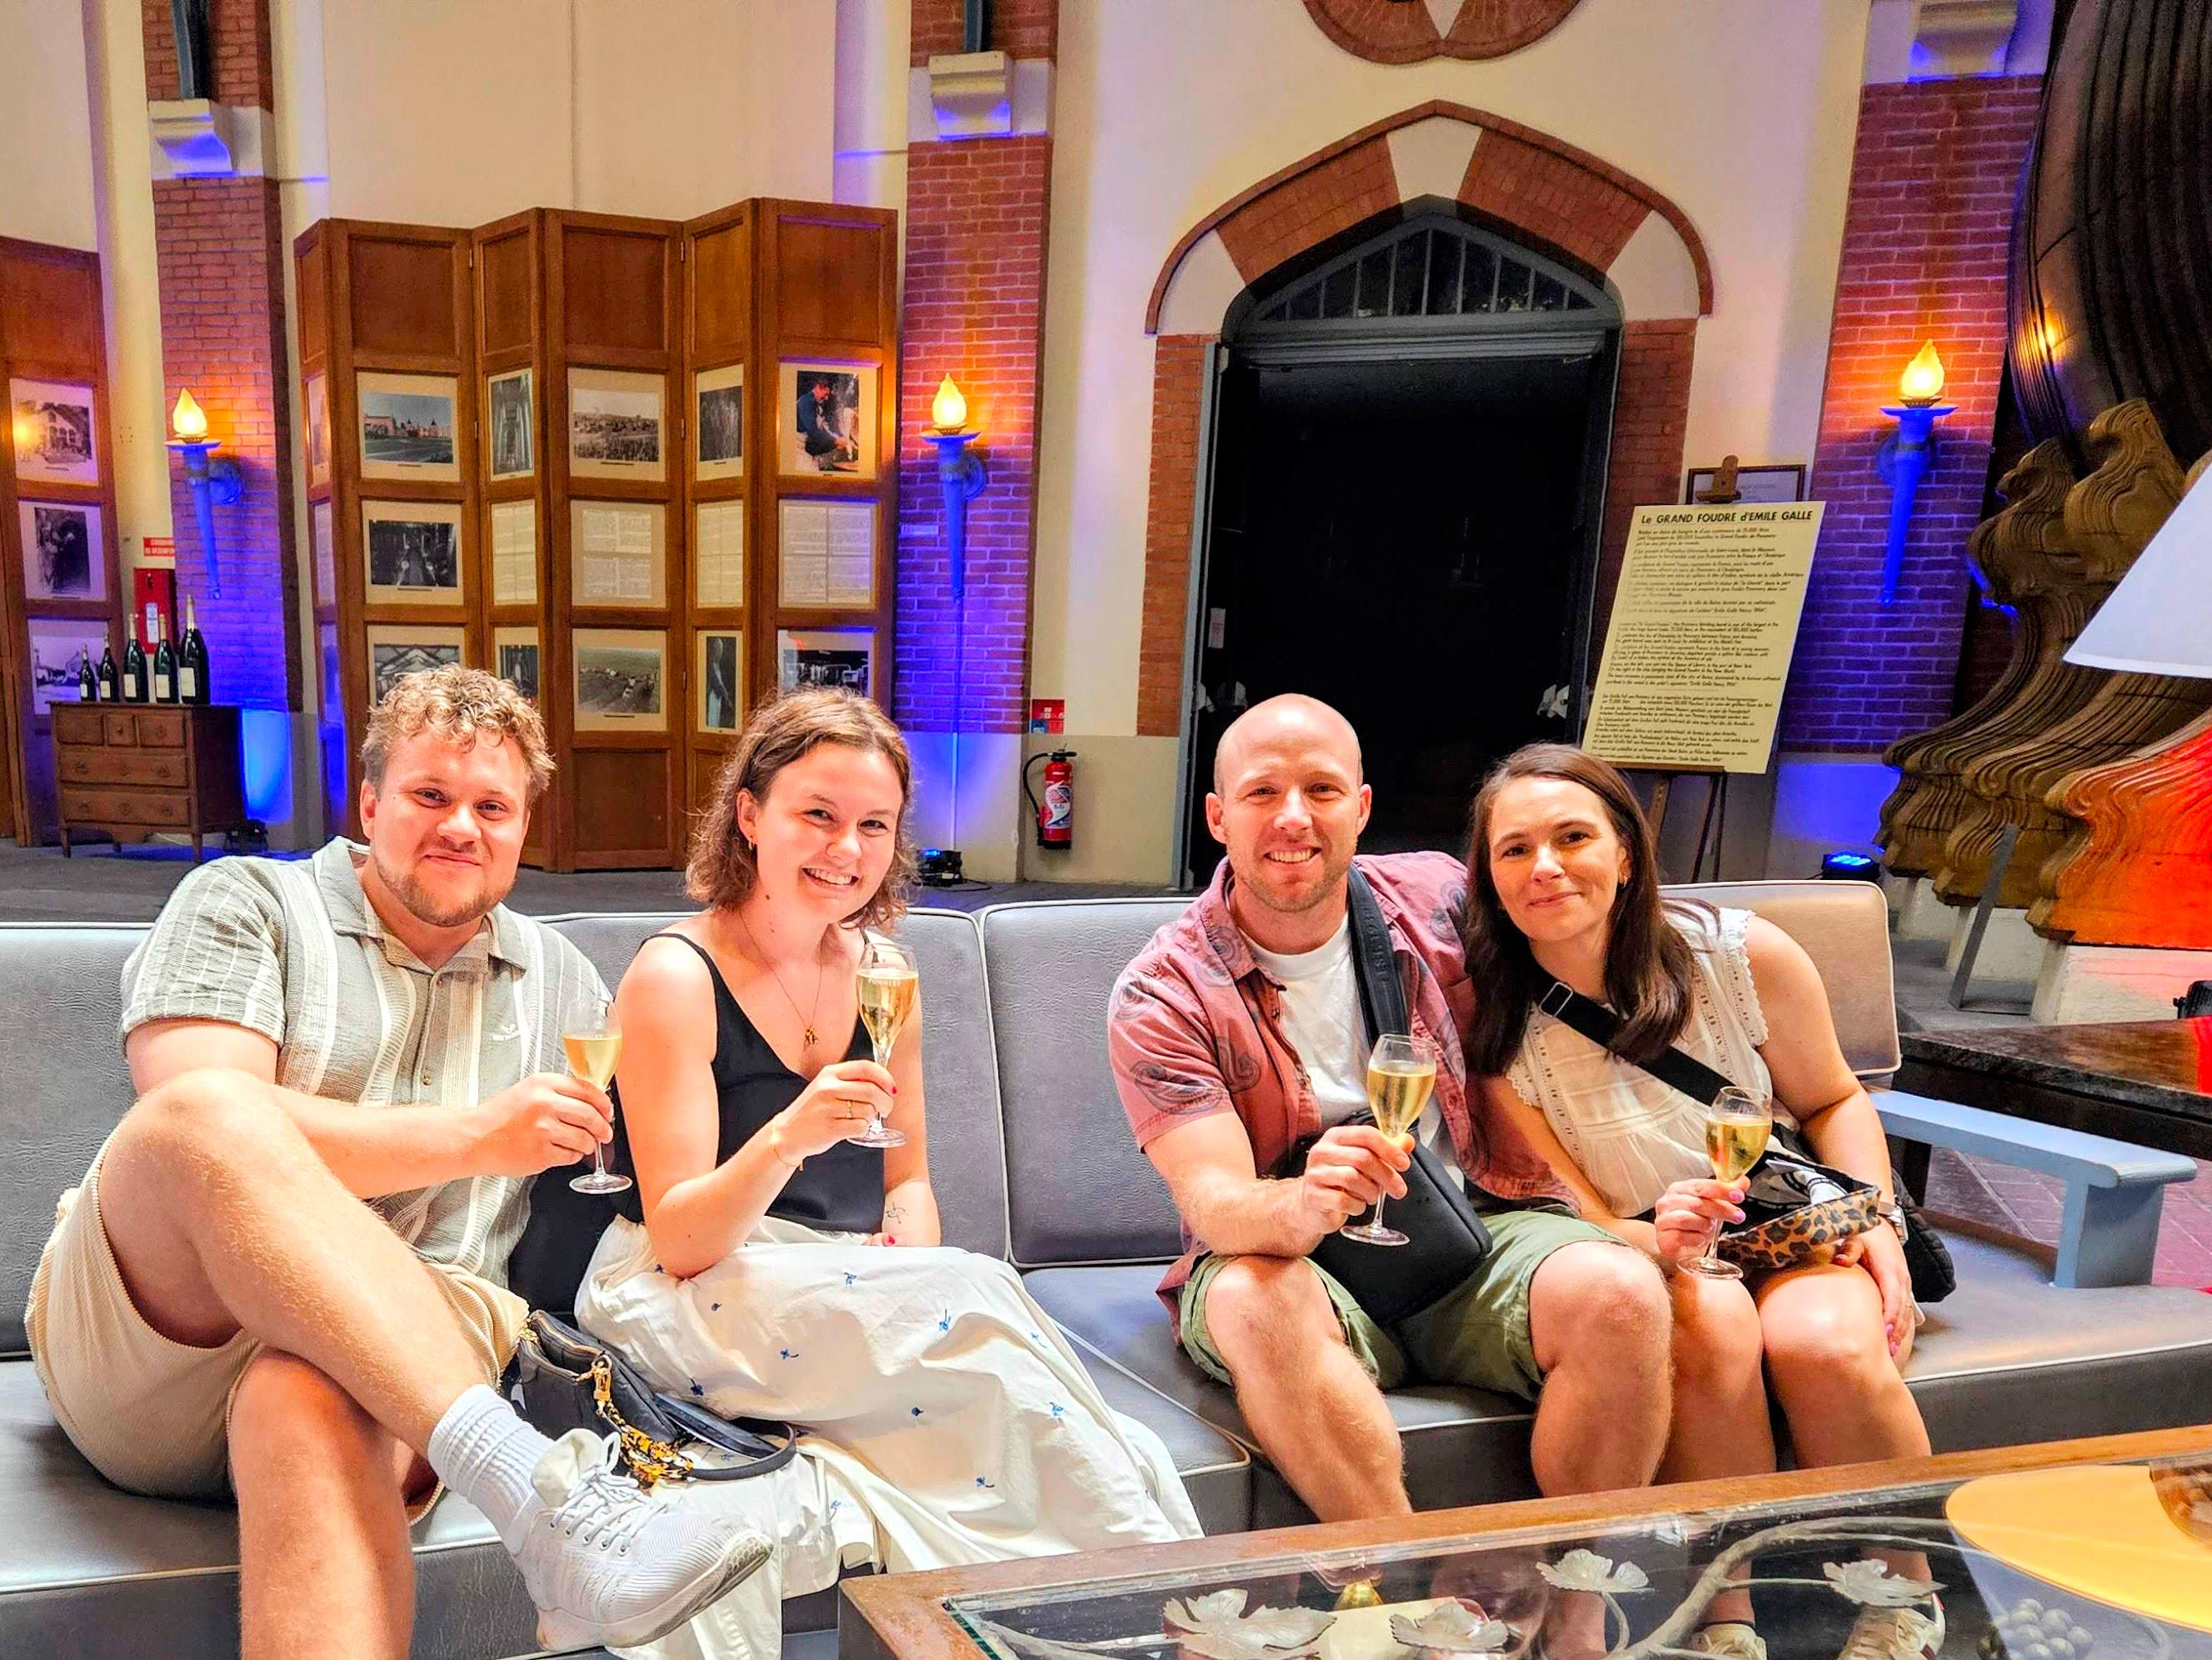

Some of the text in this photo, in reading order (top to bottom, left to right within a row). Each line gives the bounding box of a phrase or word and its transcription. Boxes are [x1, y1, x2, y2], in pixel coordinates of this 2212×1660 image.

[1641, 510, 1813, 524] Le GRAND FOUDRE d'EMILE GALLE
